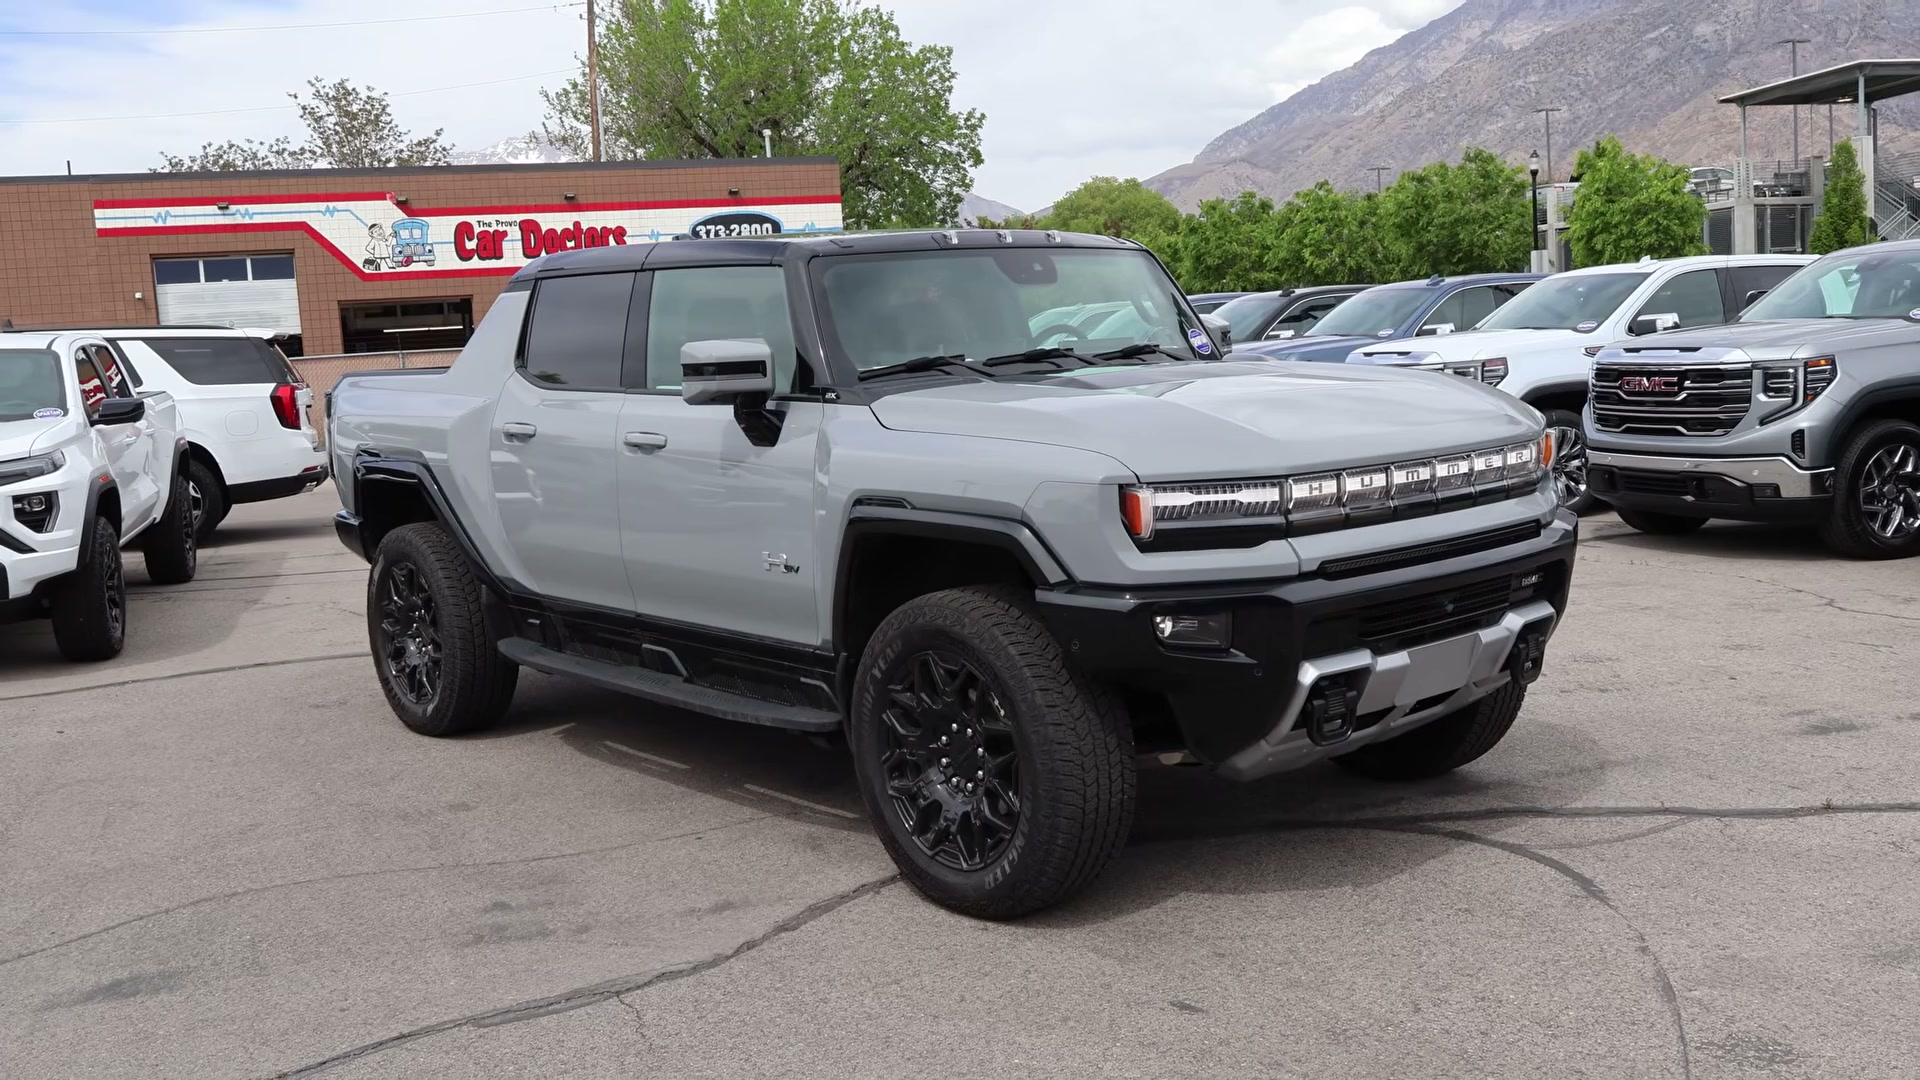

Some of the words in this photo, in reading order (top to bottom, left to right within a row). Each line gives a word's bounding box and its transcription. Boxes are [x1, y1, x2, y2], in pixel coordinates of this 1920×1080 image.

[477, 220, 492, 228] The
[495, 219, 518, 228] Provo
[454, 221, 508, 262] Car
[518, 219, 627, 259] Doctors
[1621, 376, 1678, 391] GMC
[1308, 451, 1527, 495] HUMMER
